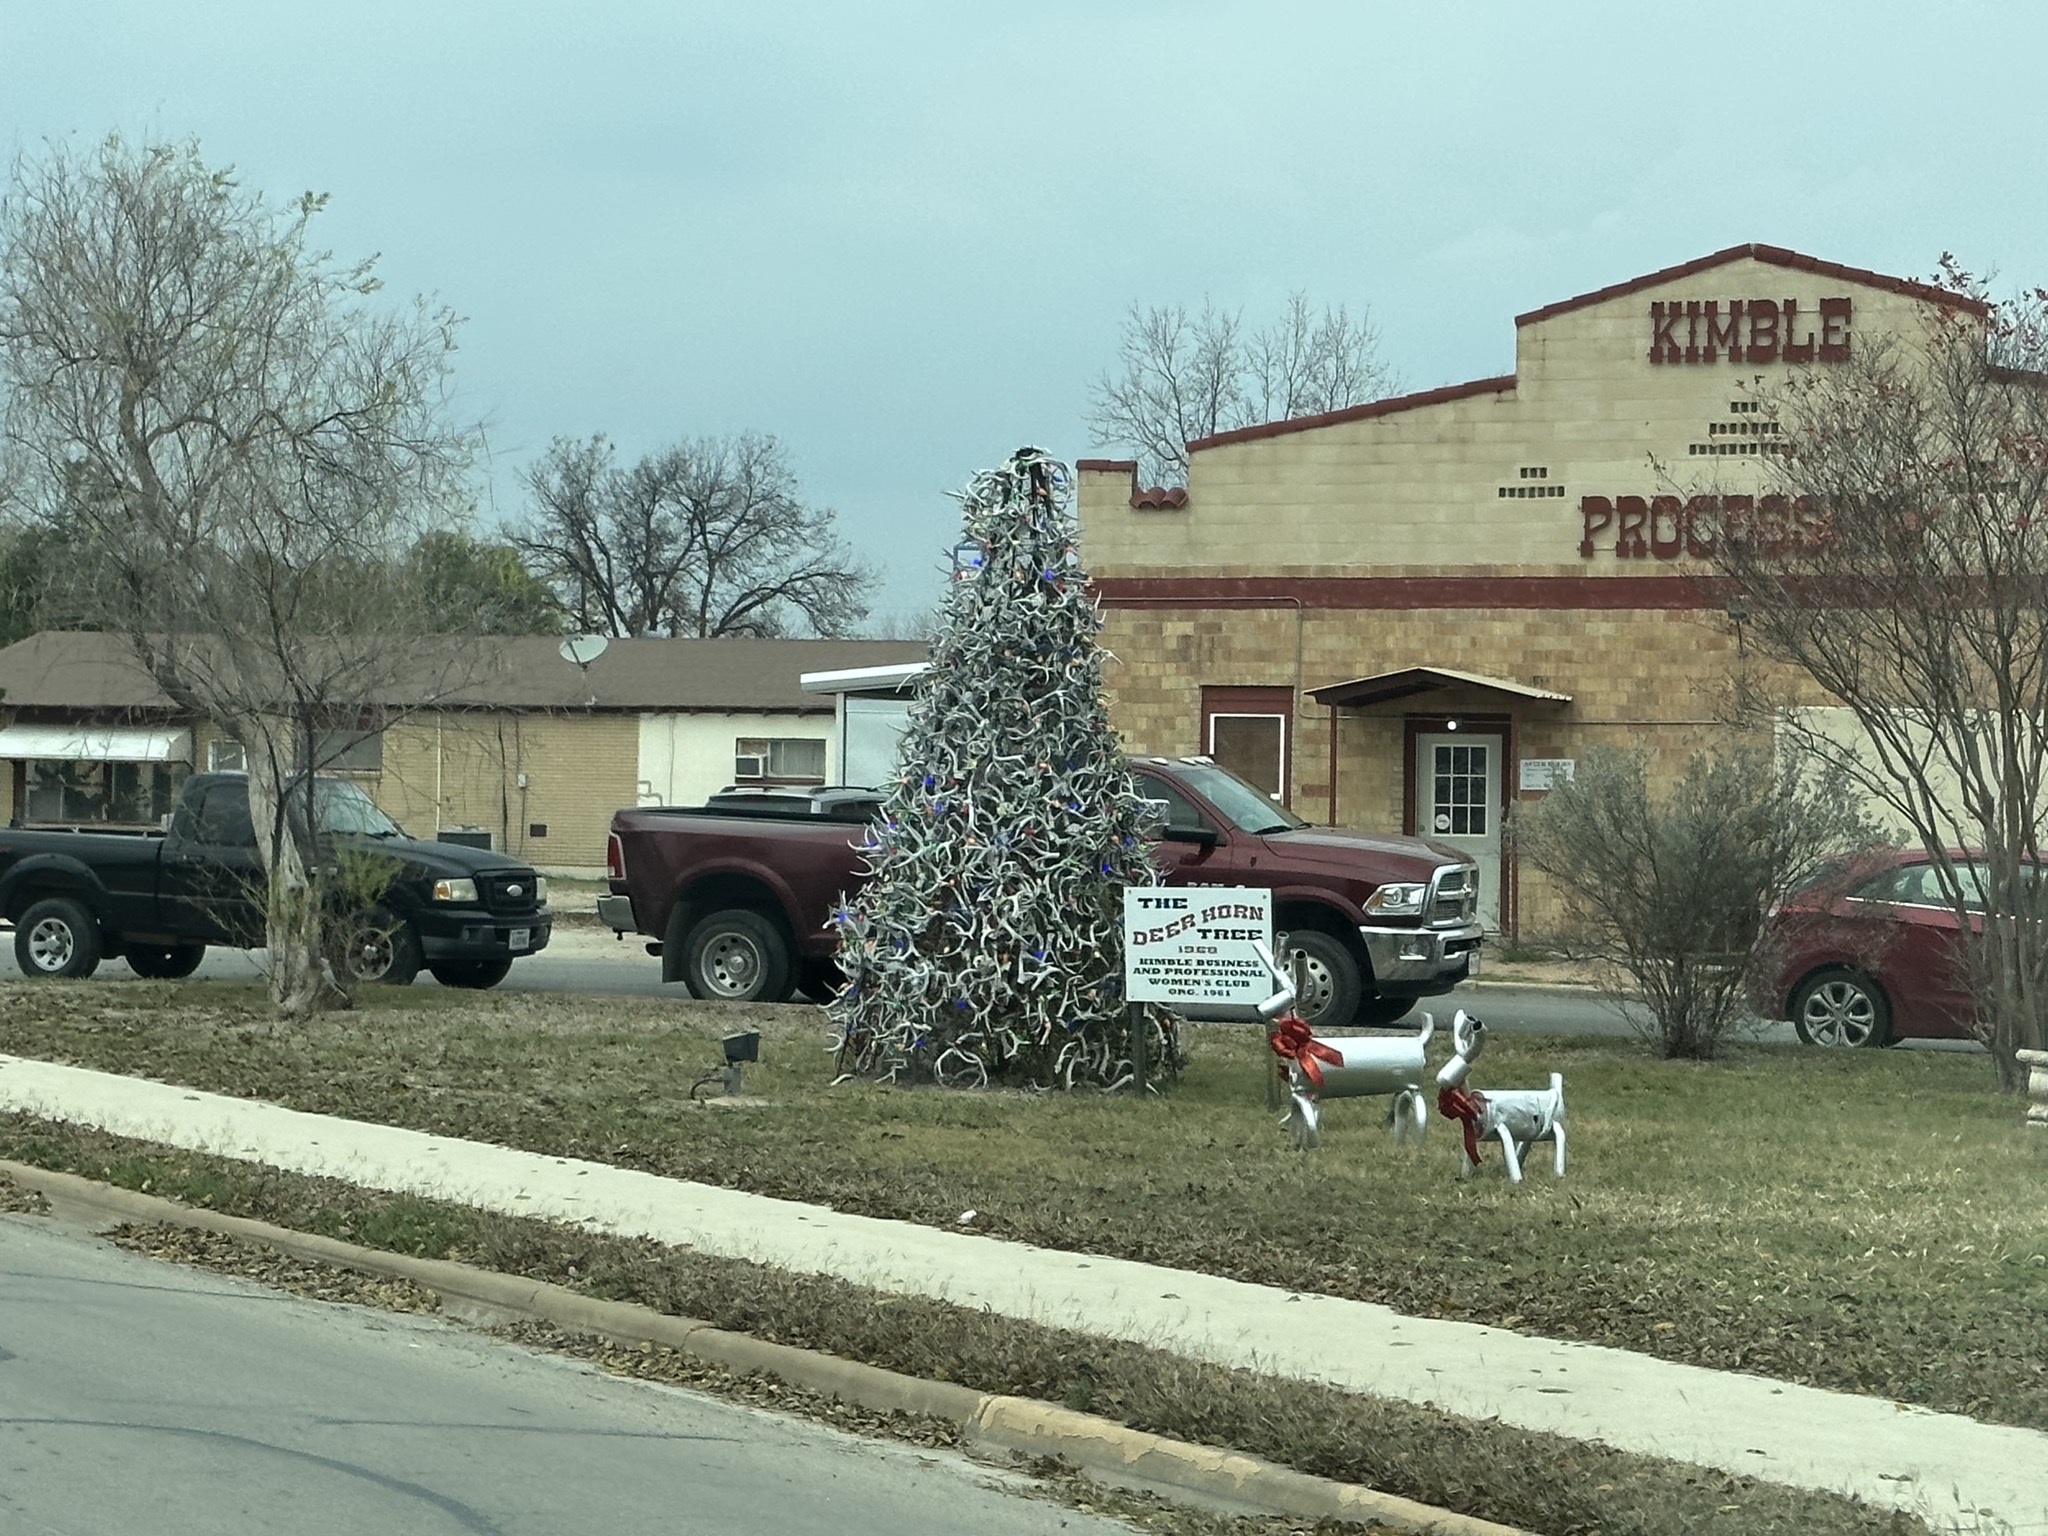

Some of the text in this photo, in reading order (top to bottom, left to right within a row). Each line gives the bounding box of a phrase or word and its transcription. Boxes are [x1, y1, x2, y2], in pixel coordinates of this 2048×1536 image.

[1649, 297, 1852, 363] KIMBLE
[1137, 897, 1188, 909] THE
[1132, 904, 1264, 946] DEER HORN
[1196, 928, 1263, 940] TREE
[1139, 958, 1260, 968] KIMBLE BUSINESS
[1133, 967, 1266, 978] AND PROFESSIONAL
[1148, 978, 1251, 988] WOMEN'S CLUB
